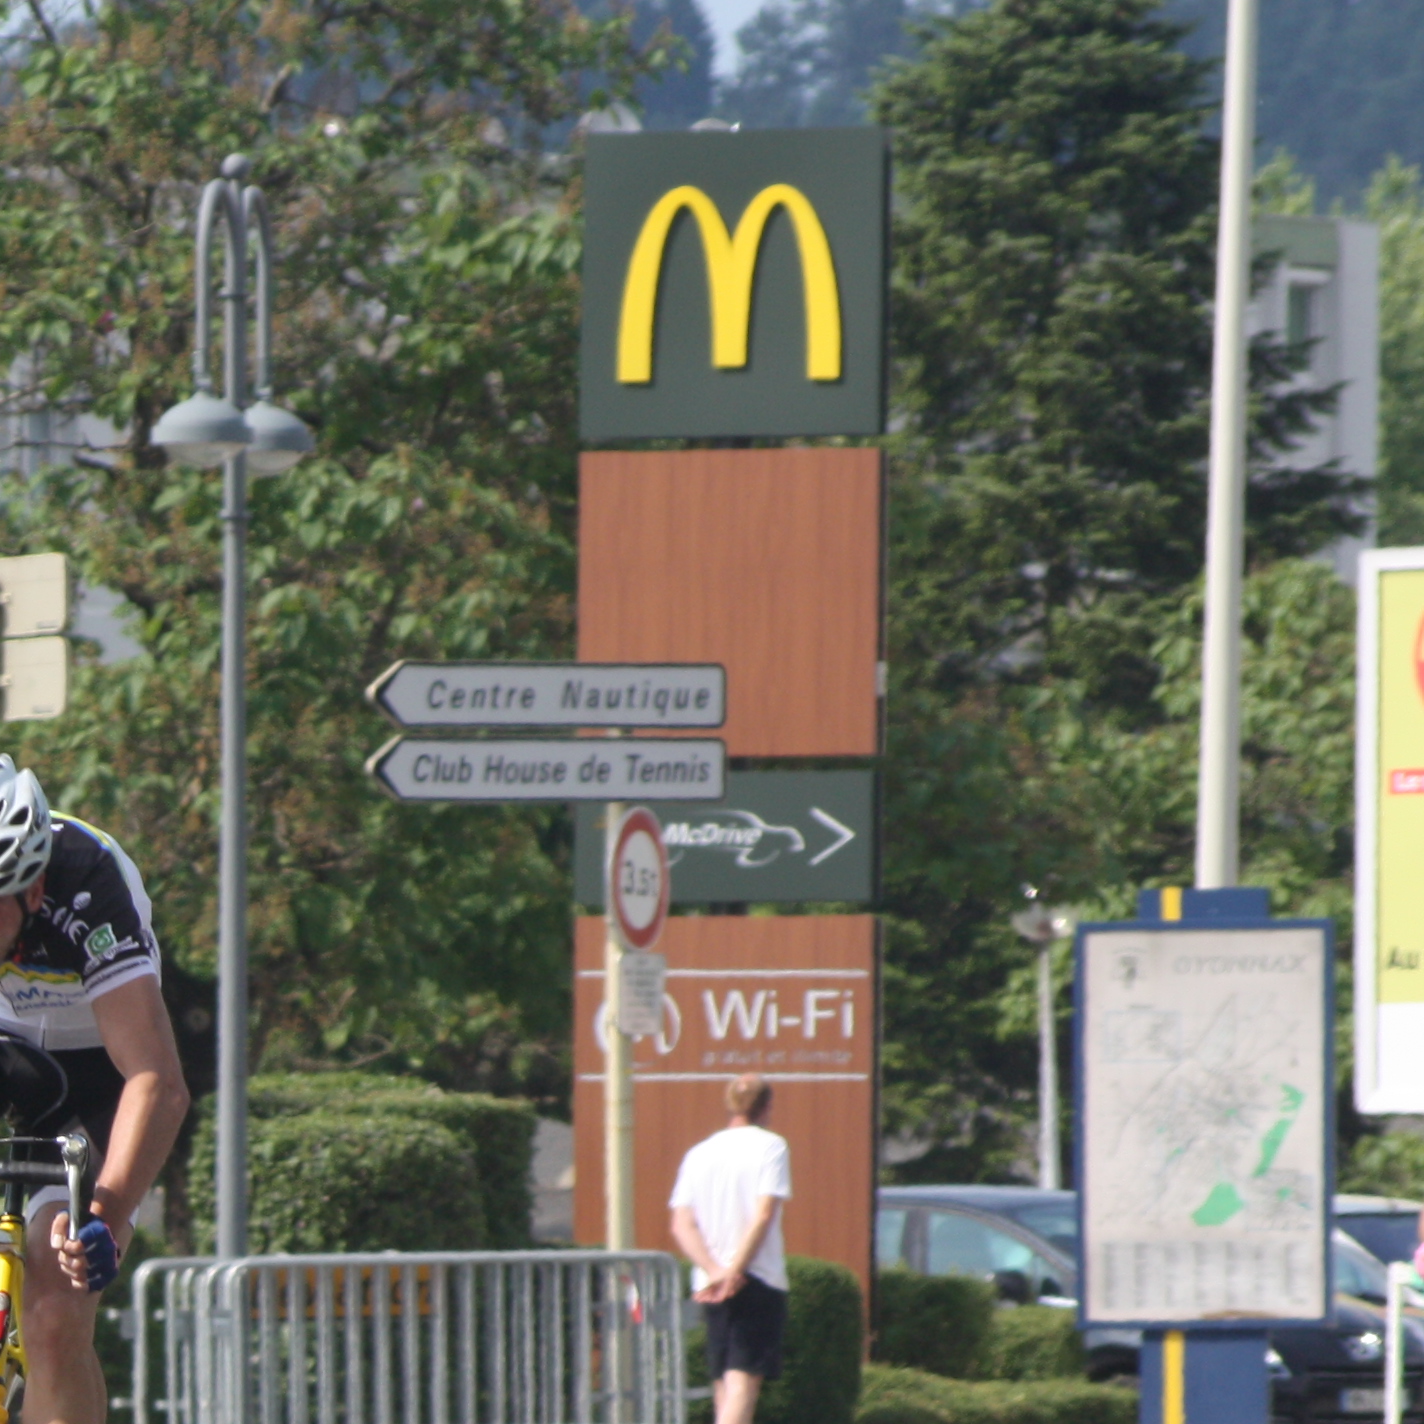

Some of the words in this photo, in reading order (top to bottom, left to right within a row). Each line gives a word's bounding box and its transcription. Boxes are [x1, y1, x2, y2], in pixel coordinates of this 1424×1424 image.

[427, 680, 536, 709] Centre
[561, 680, 710, 716] Nautique
[413, 754, 472, 782] Club
[483, 754, 567, 783] House
[578, 754, 611, 783] de
[625, 754, 710, 782] Tennis
[663, 822, 762, 846] McDrive
[703, 989, 854, 1040] Wi-Fi
